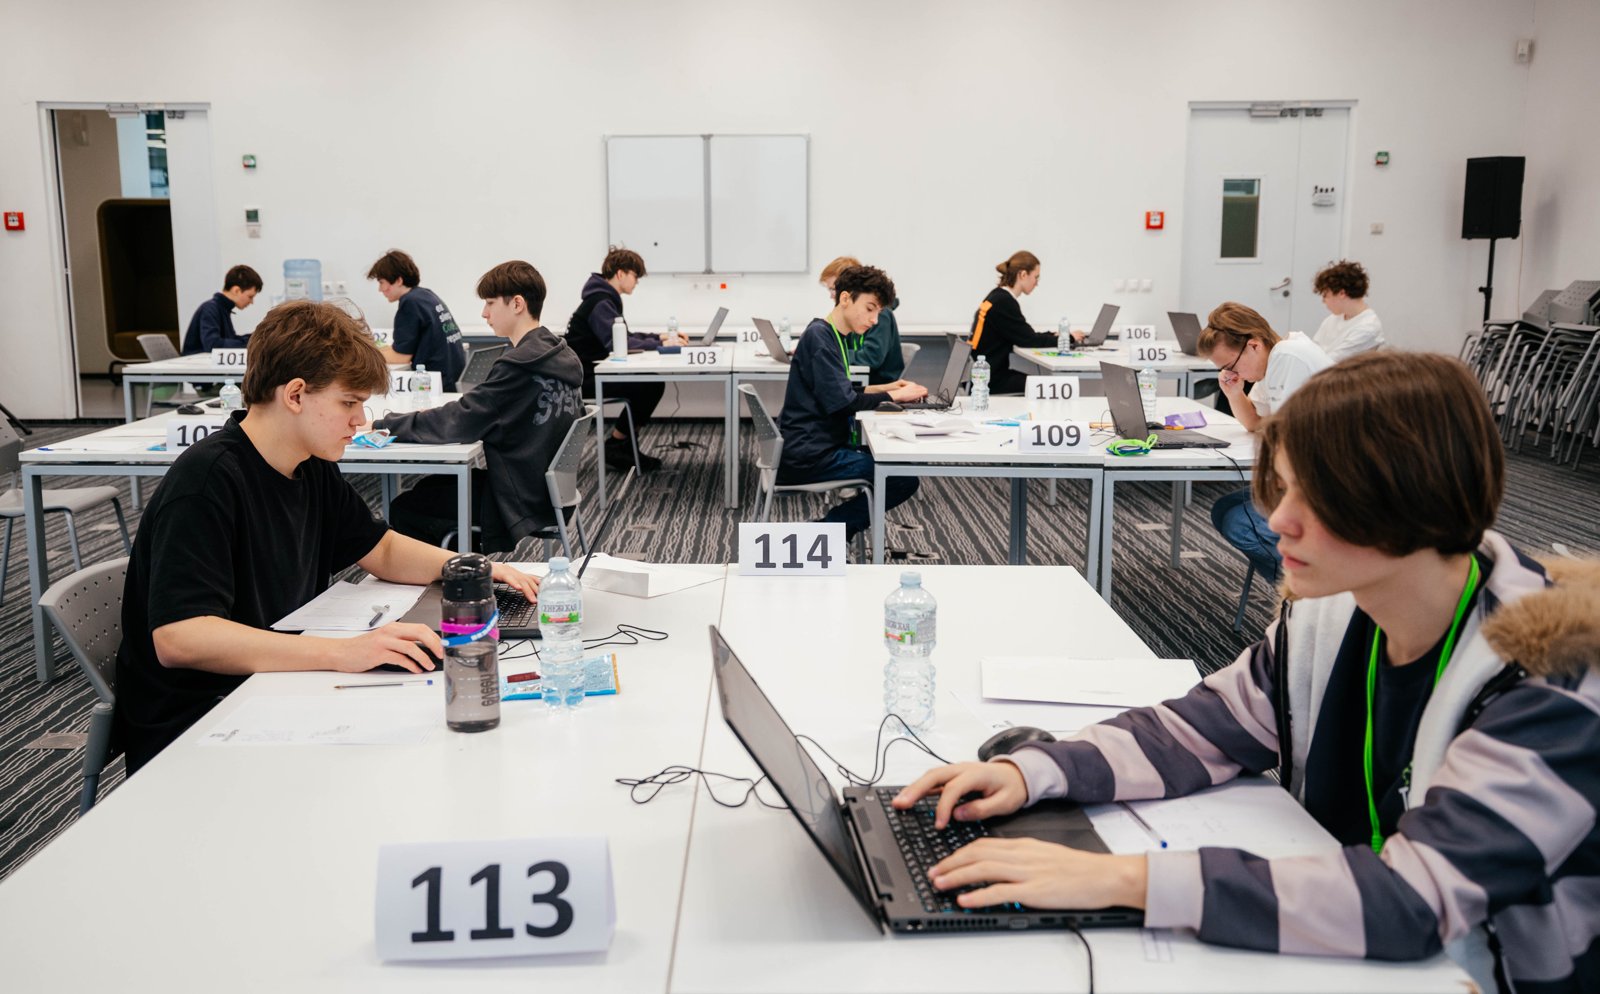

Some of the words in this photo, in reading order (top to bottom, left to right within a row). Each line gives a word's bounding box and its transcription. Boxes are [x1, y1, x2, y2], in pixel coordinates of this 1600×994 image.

[373, 332, 388, 343] 02
[743, 331, 762, 342] 10
[1126, 327, 1151, 339] 106
[217, 352, 246, 365] 101
[687, 351, 717, 365] 103
[1137, 348, 1167, 361] 105
[1036, 383, 1073, 400] 110
[1031, 425, 1081, 447] 109
[755, 533, 833, 569] 114
[411, 860, 574, 943] 113
